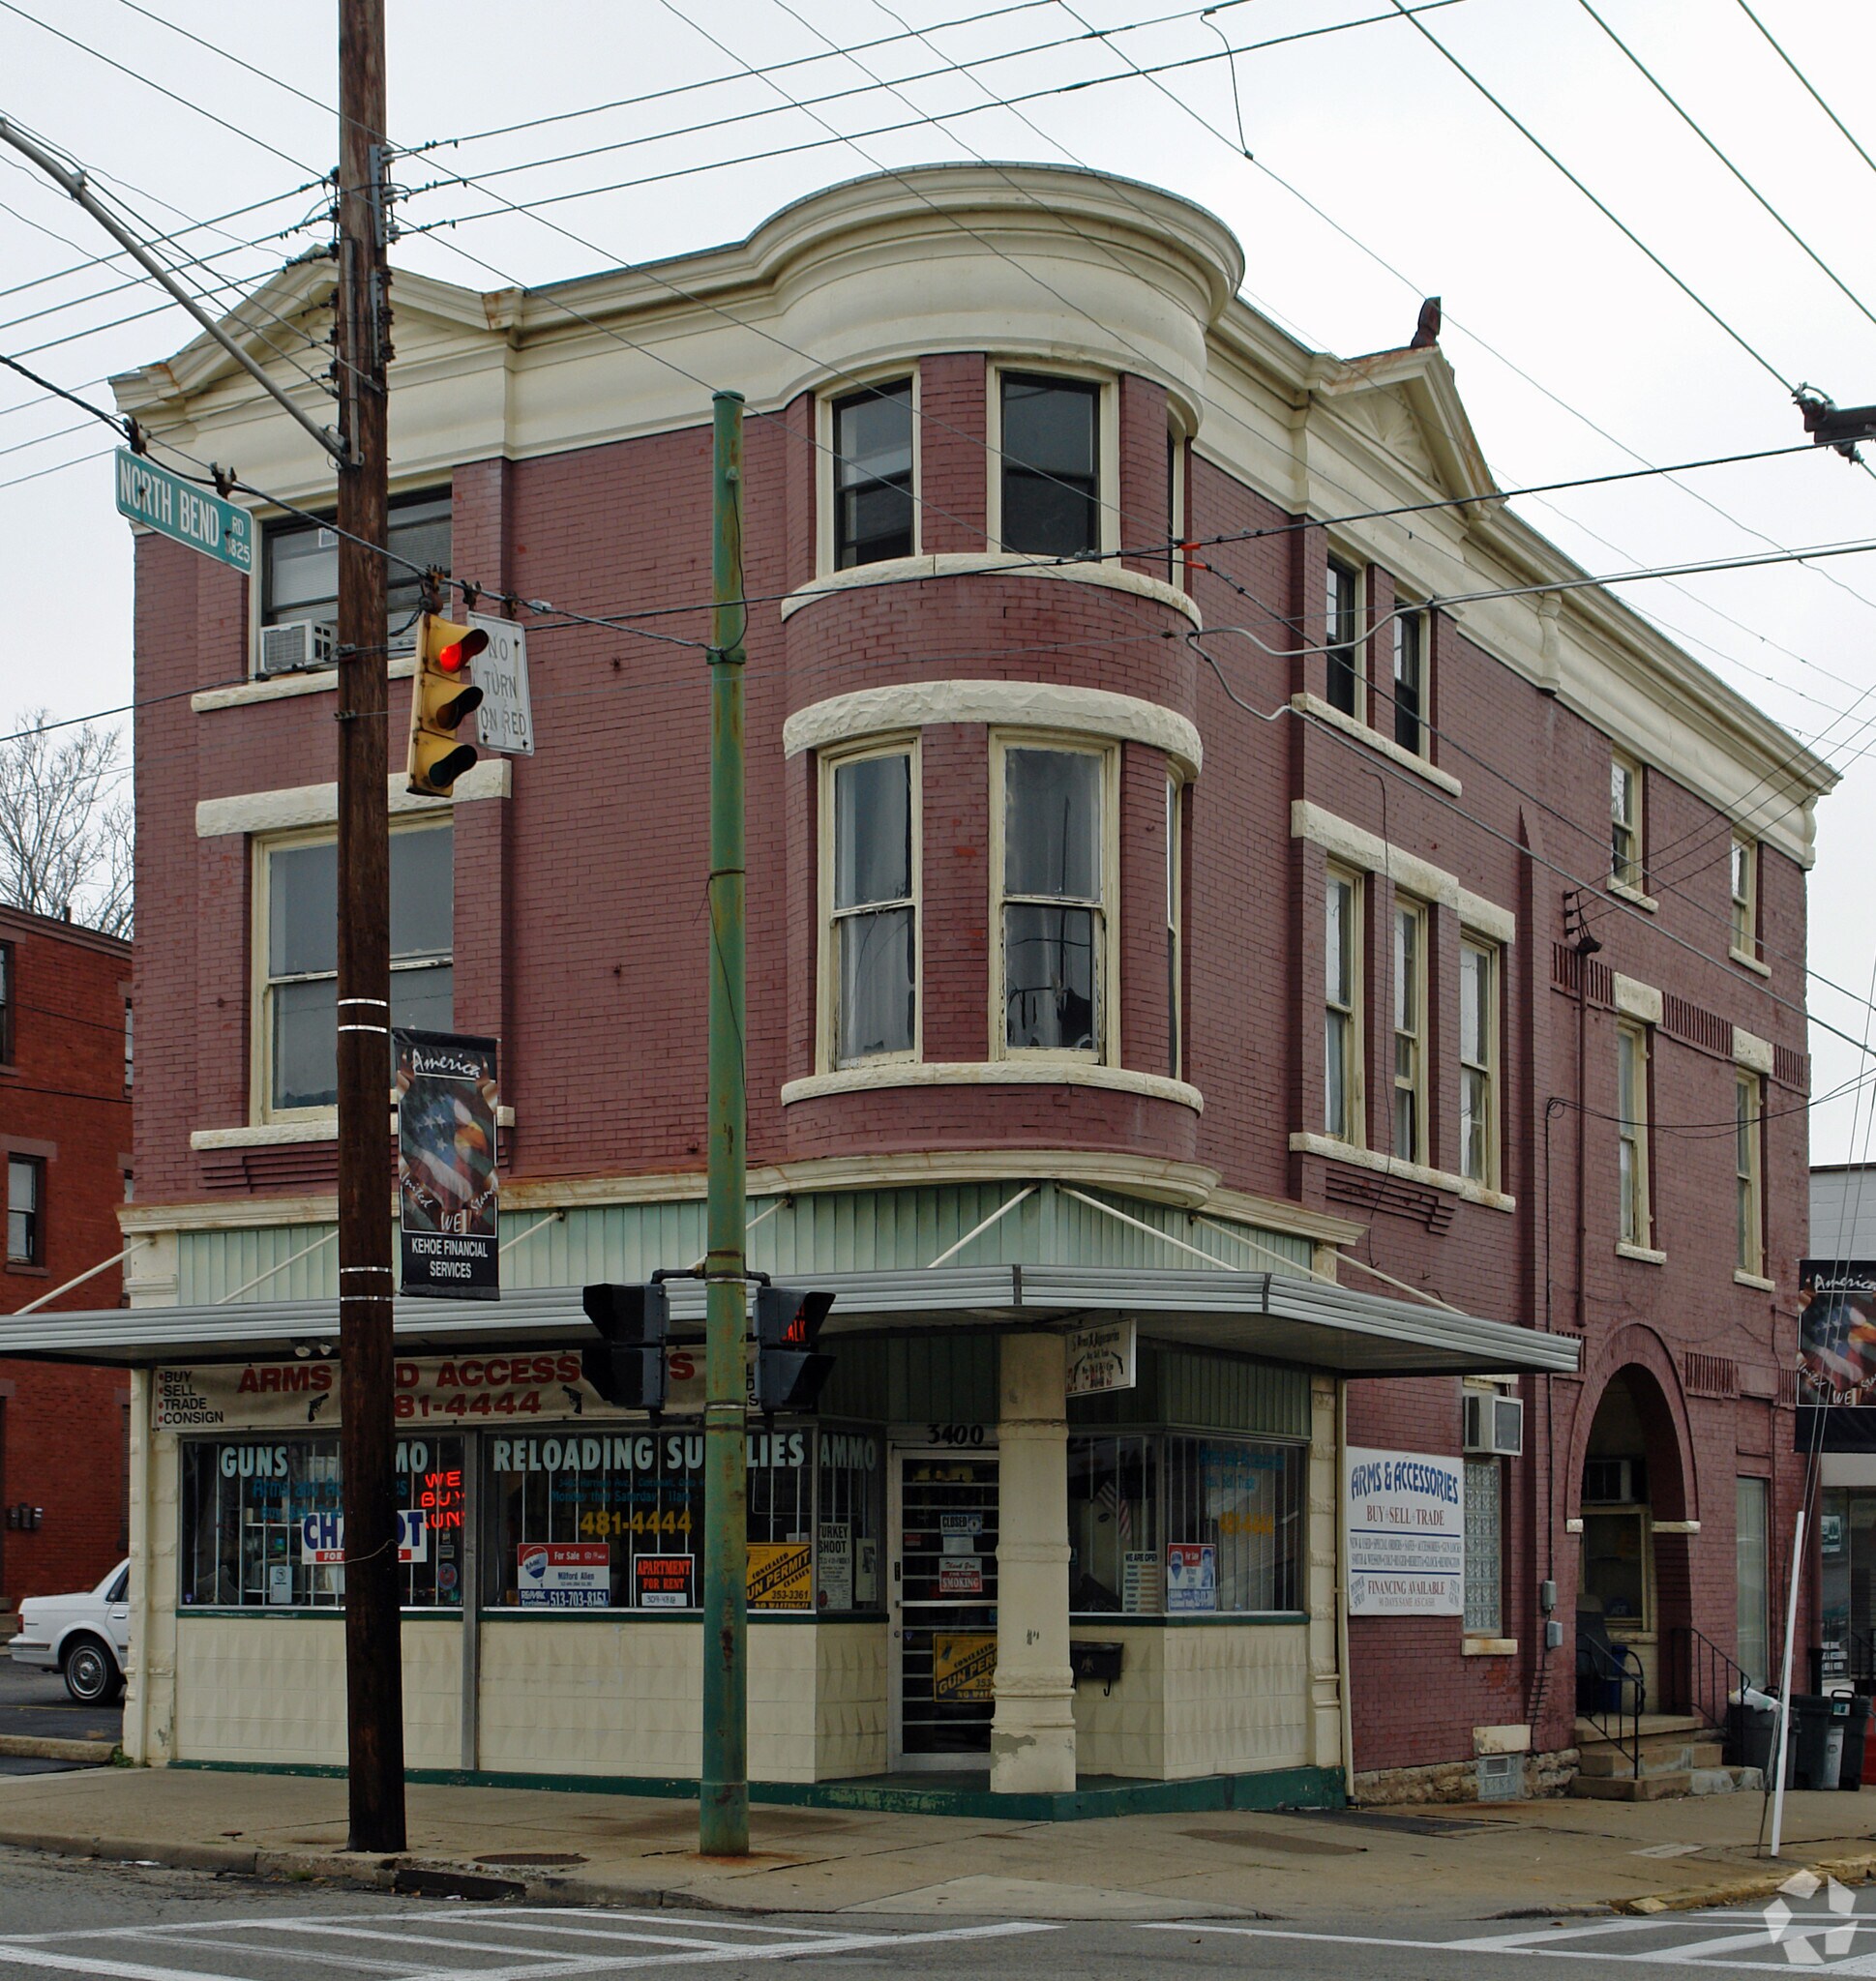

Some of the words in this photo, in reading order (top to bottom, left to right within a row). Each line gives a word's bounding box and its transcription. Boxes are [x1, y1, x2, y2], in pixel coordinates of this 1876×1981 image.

[120, 458, 172, 525] NORTH
[180, 489, 220, 547] BEND
[232, 516, 244, 537] RD
[488, 636, 508, 661] NO
[484, 670, 517, 698] TURN
[481, 706, 497, 731] ON
[503, 710, 526, 736] RED
[412, 1049, 481, 1079] America
[440, 1211, 462, 1232] WE
[411, 1237, 442, 1256] KEHOE
[443, 1239, 489, 1258] FINANCIAL
[430, 1259, 472, 1279] SERVICES
[164, 1371, 192, 1383] BUY
[237, 1365, 332, 1394] ARMS
[436, 1352, 695, 1387] ACCESSS
[164, 1384, 195, 1397] SELL
[1832, 1389, 1852, 1405] WE
[164, 1398, 207, 1410] TRADE
[394, 1391, 542, 1418] 81-4444
[164, 1411, 223, 1424] CONSIGN
[927, 1424, 984, 1444] 3400
[493, 1435, 654, 1472] RELOADING
[667, 1433, 805, 1469] SULIES
[819, 1432, 877, 1470] AMMO
[220, 1445, 288, 1478] GUNS
[425, 1470, 462, 1489] WE
[1351, 1462, 1382, 1501] ARMS
[1385, 1462, 1391, 1491] &
[1394, 1462, 1458, 1504] ACCESSORIES
[426, 1511, 465, 1529] UN
[580, 1510, 694, 1536] 481-4444
[942, 1517, 967, 1527] CLOSED
[1367, 1505, 1385, 1523] BUY
[1389, 1506, 1411, 1524] SELL
[1415, 1508, 1444, 1526] TRADE
[324, 1552, 342, 1561] FOR
[554, 1551, 565, 1560] For
[566, 1551, 580, 1560] Sale
[818, 1541, 847, 1553] SHOOT
[637, 1559, 692, 1576] APARTMENT
[747, 1579, 763, 1601] UN
[766, 1550, 811, 1589] PERMIT
[752, 1552, 789, 1580] CONCEALED
[642, 1578, 660, 1590] FOR
[663, 1578, 685, 1590] RENT
[784, 1568, 810, 1587] CLASSES
[942, 1577, 979, 1589] SMOKING
[1368, 1580, 1407, 1594] FINANCING
[1408, 1581, 1445, 1595] AVAILABLE
[772, 1590, 809, 1600] 353-3361
[954, 1642, 995, 1669] CONCEALED
[938, 1669, 967, 1695] GUN
